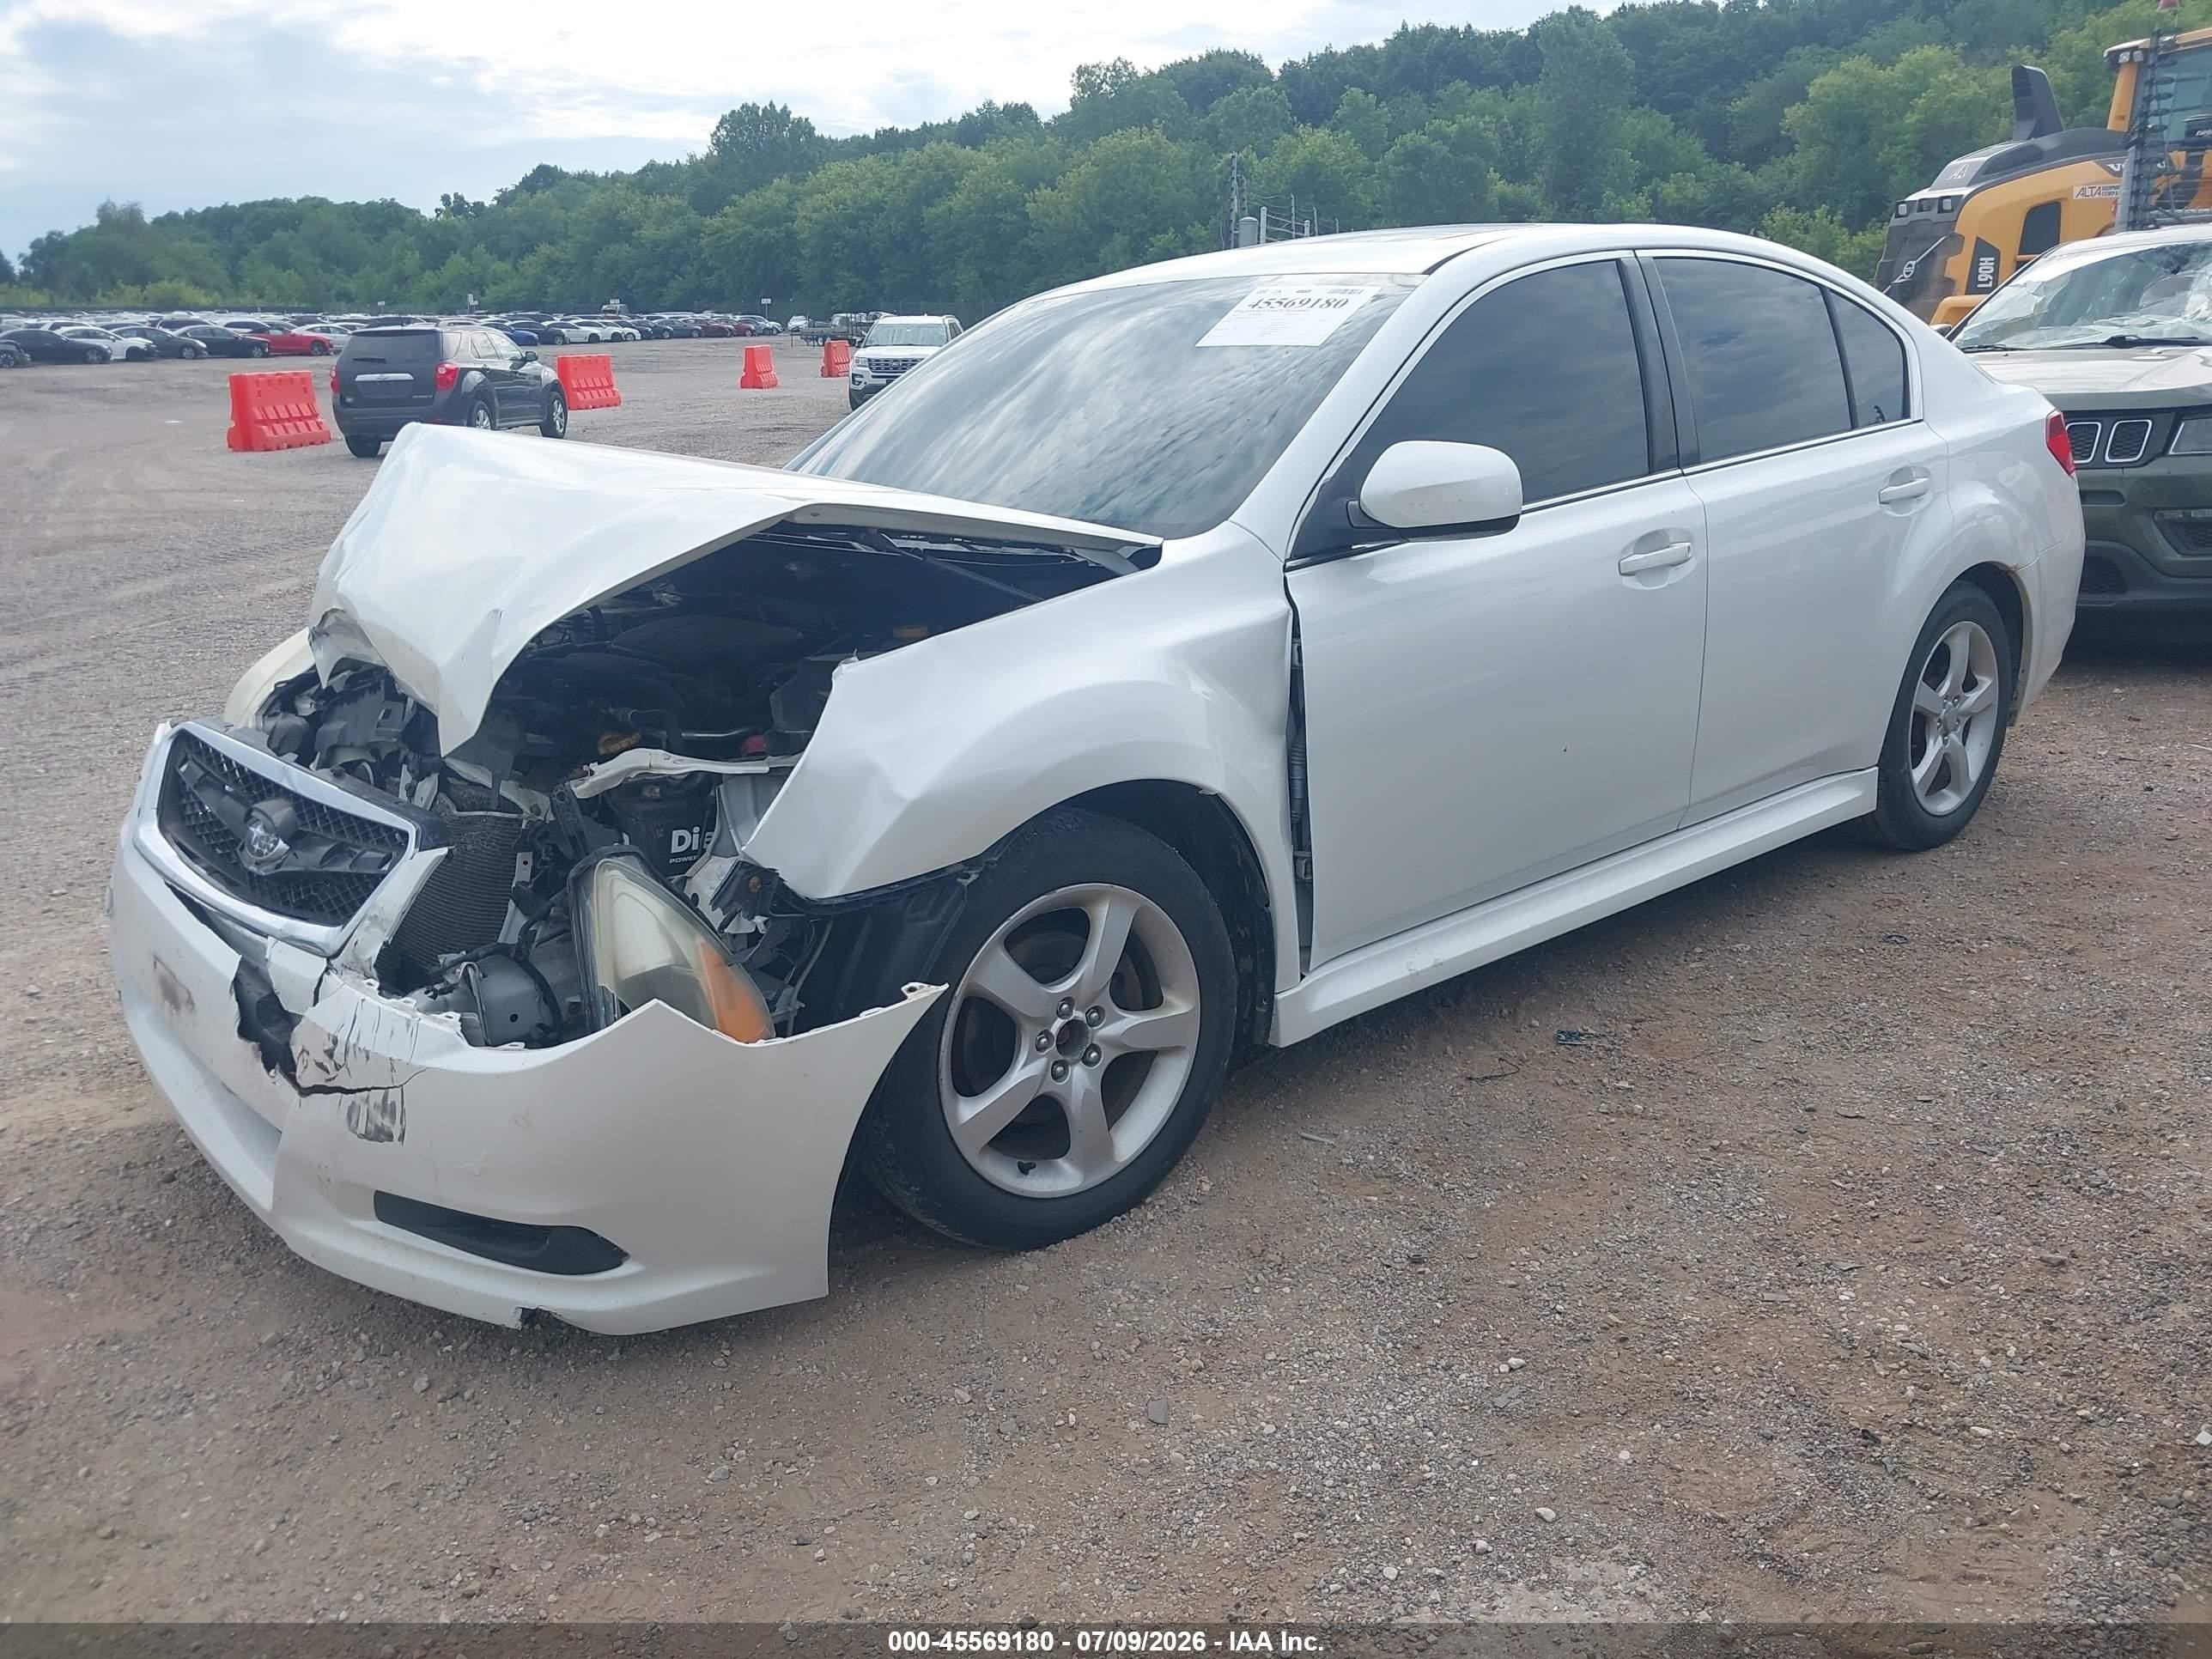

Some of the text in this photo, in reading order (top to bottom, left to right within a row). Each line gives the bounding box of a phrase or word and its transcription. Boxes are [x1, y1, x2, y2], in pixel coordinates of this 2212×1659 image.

[2075, 185, 2102, 198] ALTA
[1977, 257, 1995, 289] L90H
[1248, 297, 1349, 309] 45569180
